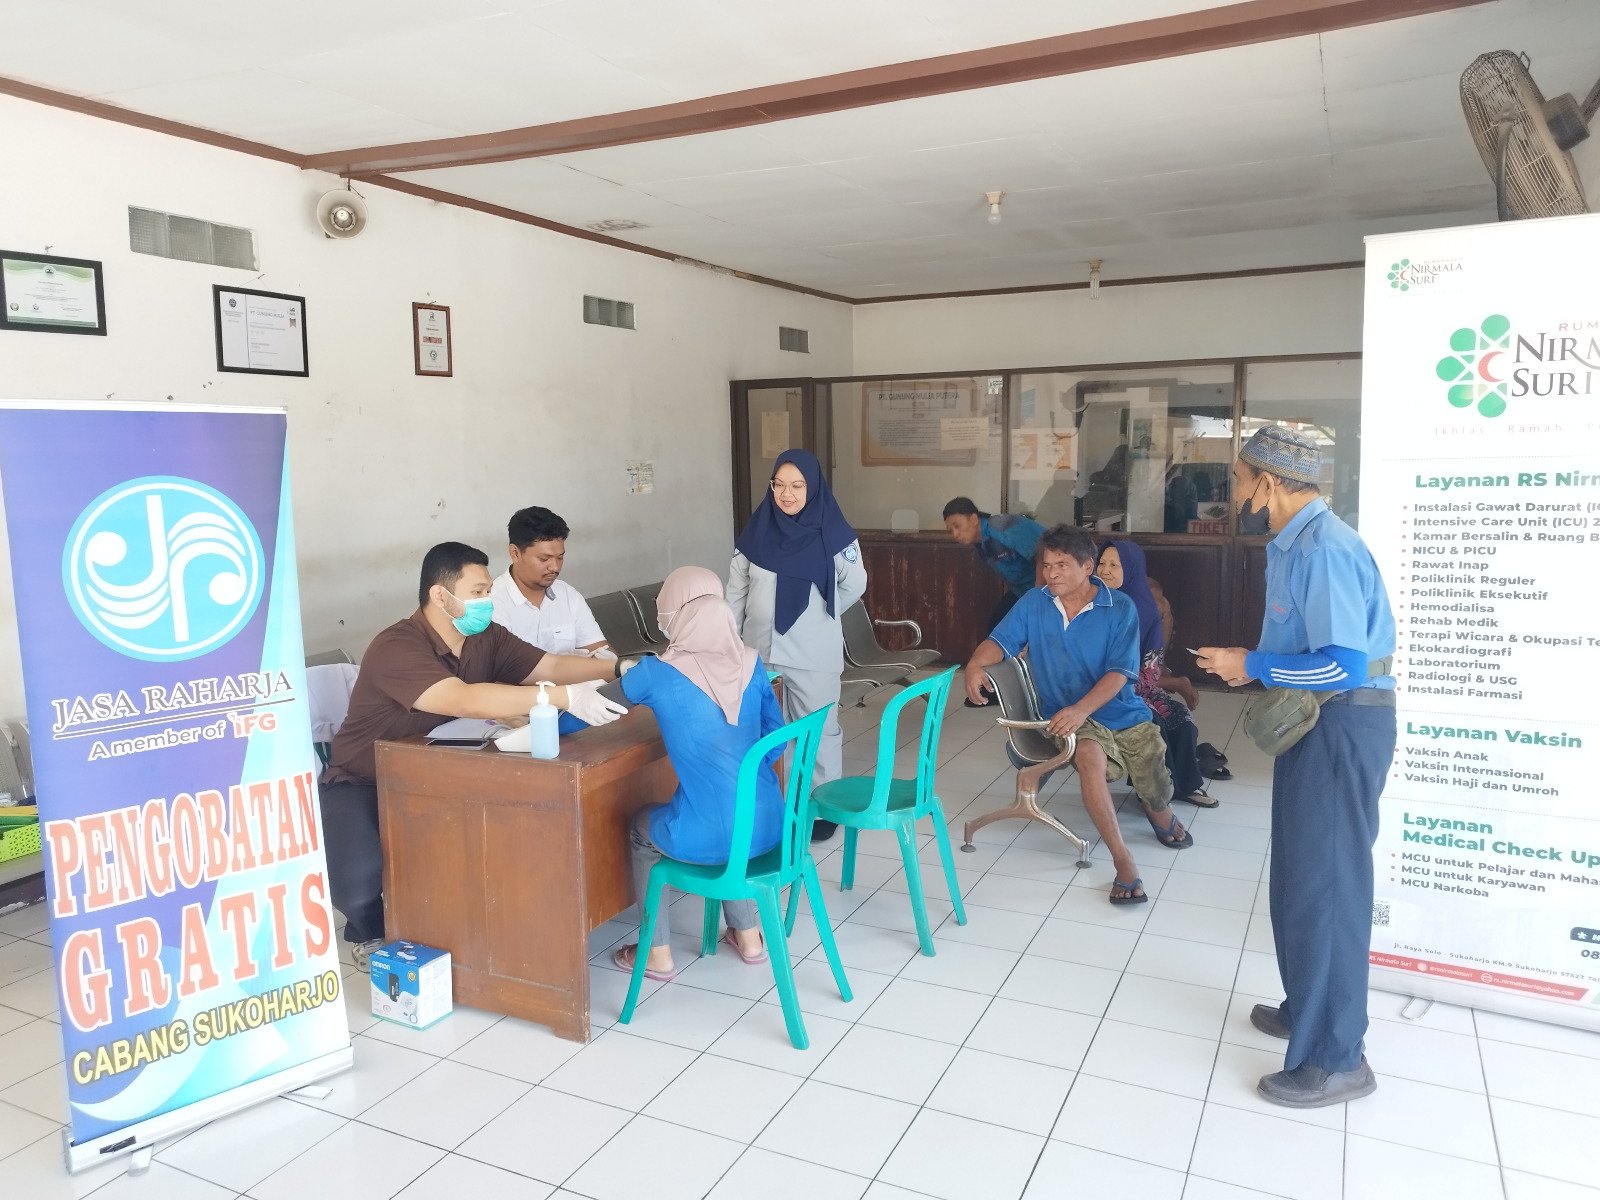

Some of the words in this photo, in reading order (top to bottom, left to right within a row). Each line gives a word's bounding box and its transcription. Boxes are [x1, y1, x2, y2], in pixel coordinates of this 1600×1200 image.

[1411, 263, 1464, 275] NIRMALA
[1410, 275, 1435, 285] SURI
[1511, 367, 1593, 397] SURI
[1415, 475, 1510, 491] Layanan
[1517, 472, 1548, 487] RS
[1414, 502, 1472, 512] Instalasi
[1476, 503, 1521, 512] Gawat
[1525, 503, 1582, 512] Darurat
[1190, 521, 1229, 534] TIKET
[1413, 517, 1476, 526] Intensive
[1481, 517, 1513, 527] Care
[1518, 517, 1548, 527] Unit
[1552, 517, 1588, 529] (ICU)
[1413, 532, 1457, 541] Kamar
[1461, 531, 1519, 541] Bersalin
[1523, 532, 1533, 541] &
[1537, 532, 1585, 544] Ruang
[1412, 546, 1446, 555] NICU
[1450, 546, 1459, 555] &
[1463, 546, 1497, 555] PICU
[1412, 560, 1455, 570] Rawat
[1458, 561, 1489, 572] Inap
[1411, 574, 1476, 584] Poliklinik
[1480, 575, 1536, 587] Reguler
[1411, 588, 1475, 599] Poliklinik
[1480, 589, 1548, 601] Eksekutif
[1410, 602, 1495, 613] Hemodialisa
[1410, 616, 1452, 626] Rehab
[1456, 617, 1499, 628] Medik
[1410, 630, 1451, 642] Terapi
[1455, 631, 1504, 642] Wicara
[1508, 634, 1518, 643] &
[1522, 635, 1582, 647] Okupasi
[1409, 644, 1512, 657] Ekokardiografi
[1408, 657, 1501, 671] Laboratorium
[1408, 671, 1472, 684] Radiologi
[1475, 675, 1485, 684] &
[1489, 676, 1518, 686] USG
[1408, 685, 1464, 697] Instalasi
[1467, 688, 1523, 700] Farmasi
[54, 690, 139, 732] JASA
[144, 670, 293, 711] RAHARJA
[91, 741, 109, 760] A
[112, 728, 200, 755] member
[204, 721, 225, 740] of
[1406, 722, 1498, 741] Layanan
[1504, 729, 1582, 749] Vaksin
[1405, 746, 1450, 758] Vaksin
[1453, 750, 1489, 762] Anak
[1405, 759, 1449, 771] Vaksin
[1453, 764, 1544, 781] Internasional
[1404, 773, 1448, 785] Vaksin
[1452, 777, 1478, 789] Haji
[1482, 781, 1508, 791] dan
[1512, 784, 1559, 797] Umroh
[1403, 812, 1493, 835] Layanan
[46, 772, 320, 917] PENGOBATAN
[1403, 829, 1485, 852] Medical
[1491, 841, 1563, 862] Check
[1570, 850, 1600, 869] Up
[1401, 852, 1431, 863] MCU
[1434, 857, 1474, 869] untuk
[1478, 862, 1526, 877] Pelajar
[1529, 868, 1556, 880] dan
[1560, 873, 1600, 886] Maha
[1401, 864, 1430, 876] MCU
[1434, 870, 1473, 882] untuk
[1477, 875, 1546, 893] Karyawan
[1400, 877, 1430, 889] MCU
[1433, 882, 1489, 898] Narkoba
[63, 871, 331, 1031] GRATIS
[1581, 949, 1600, 960] 08
[1449, 952, 1490, 964] Sukoharjo
[1515, 963, 1558, 976] Sukoharjo
[73, 1023, 190, 1086] CABANG
[193, 970, 339, 1046] SUKOHARJO
